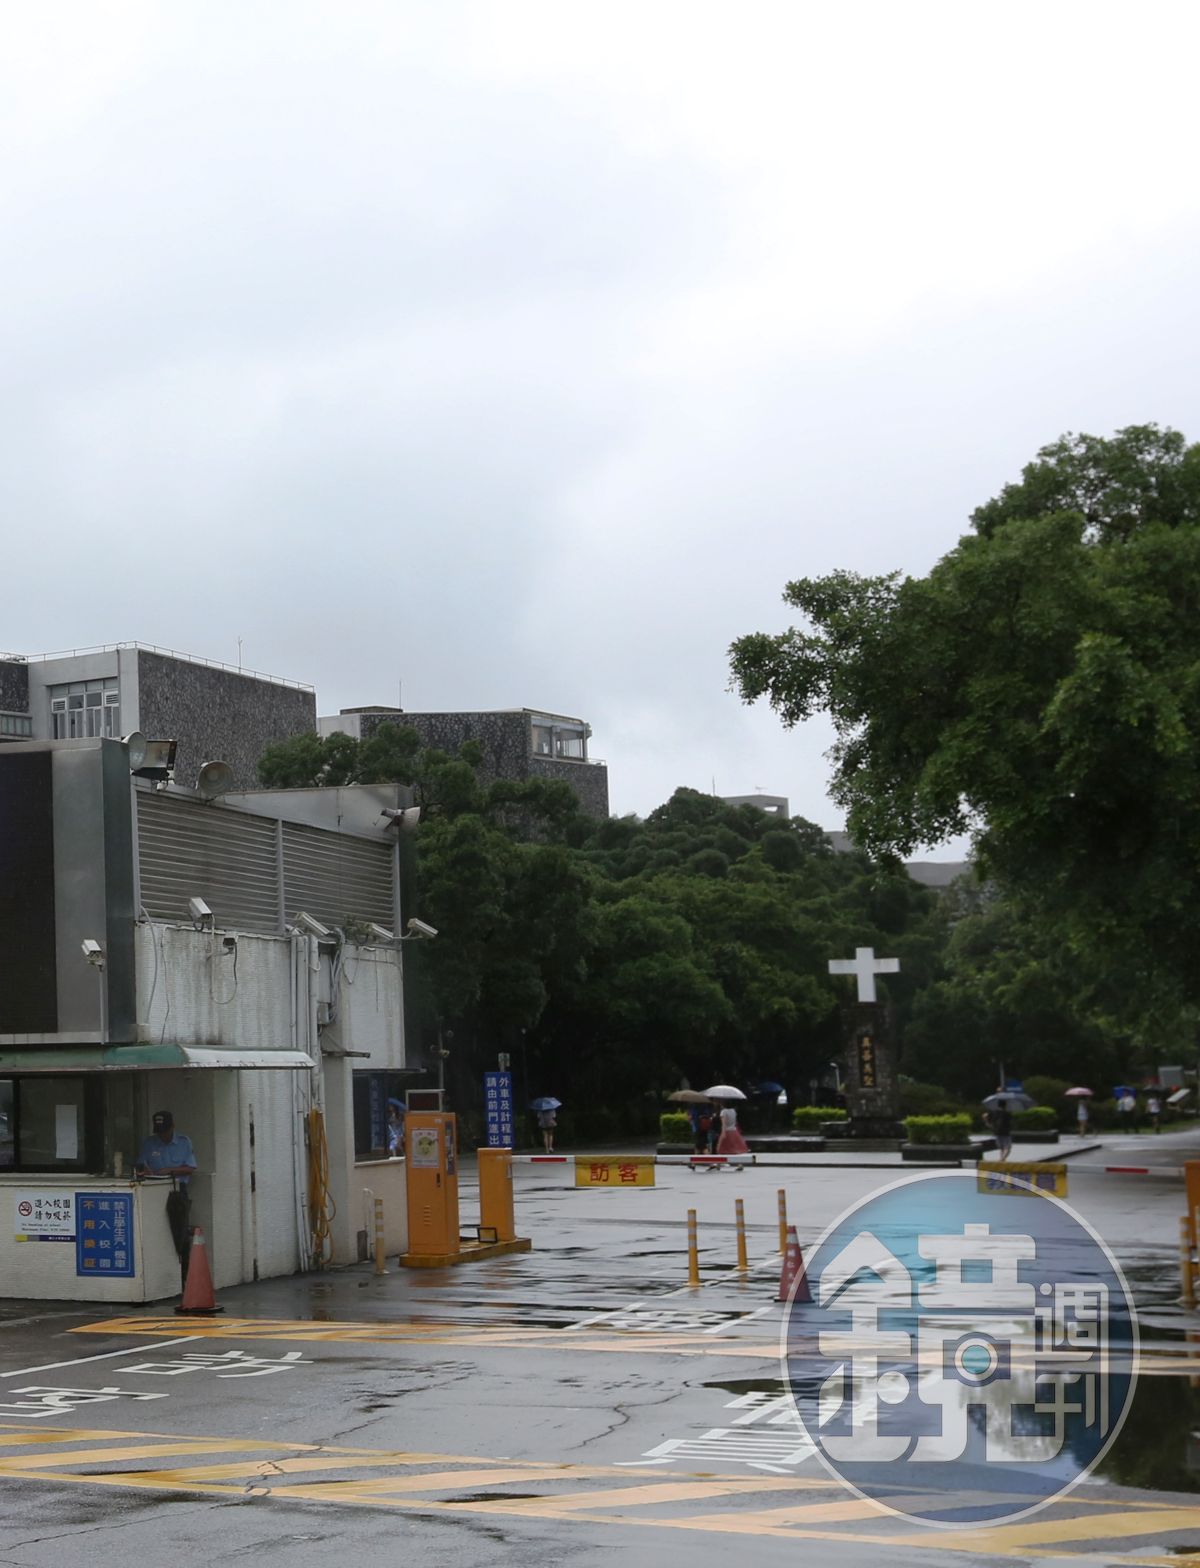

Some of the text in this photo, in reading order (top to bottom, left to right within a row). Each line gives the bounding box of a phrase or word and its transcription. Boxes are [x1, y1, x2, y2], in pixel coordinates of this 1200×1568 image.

[486, 1077, 500, 1145] 請由前門進出
[499, 1077, 513, 1145] 外車及計程車
[590, 1163, 640, 1182] 訪客
